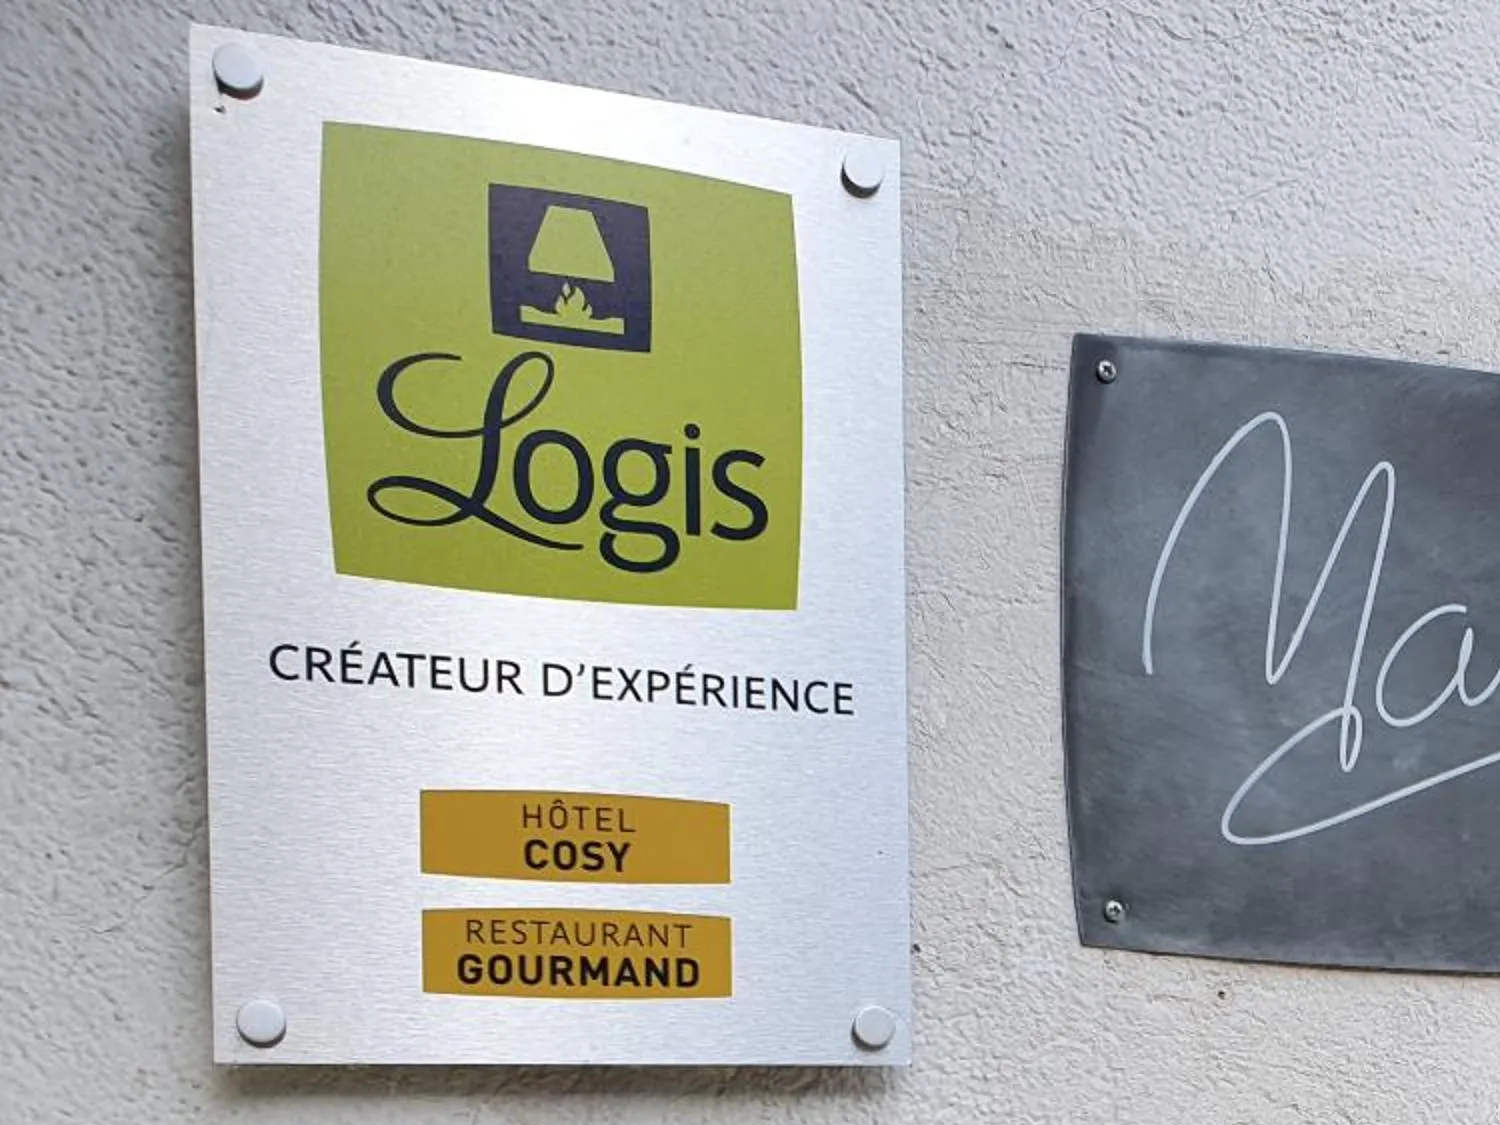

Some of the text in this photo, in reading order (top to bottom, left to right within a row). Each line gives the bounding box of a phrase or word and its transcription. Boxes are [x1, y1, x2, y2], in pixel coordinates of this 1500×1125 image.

[367, 351, 769, 573] Logis
[268, 640, 855, 716] CRÉATEUR D'EXPÉRIENCE
[521, 799, 637, 834] HÔTEL
[522, 839, 632, 873] COSY
[465, 919, 694, 950] RESTAURANT
[456, 953, 700, 989] GOURMAND
